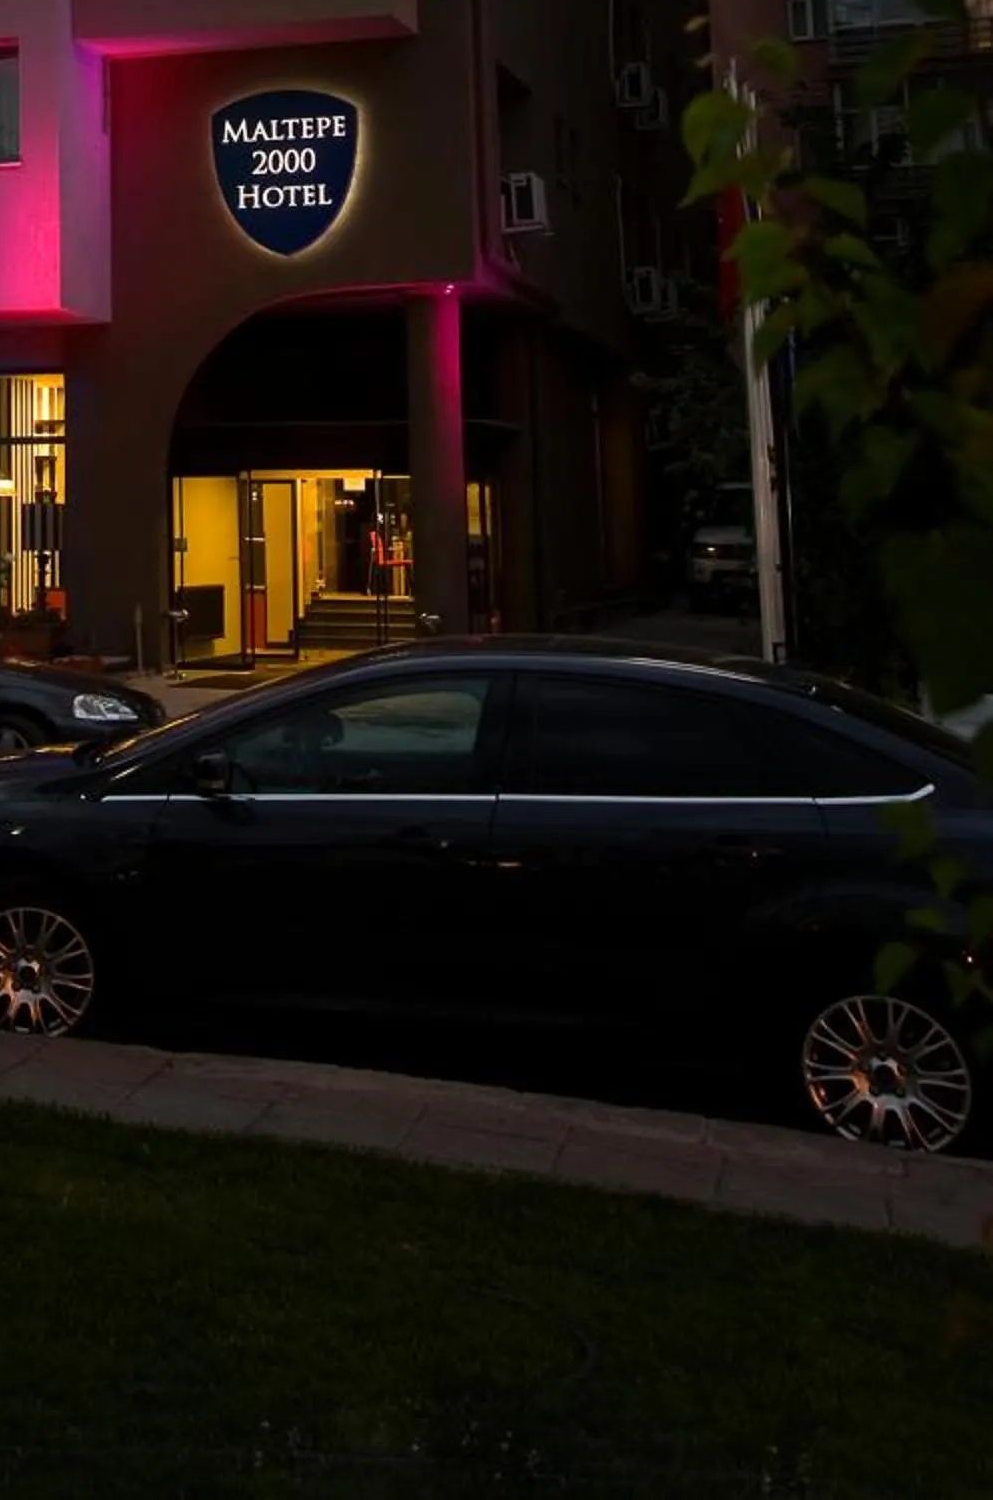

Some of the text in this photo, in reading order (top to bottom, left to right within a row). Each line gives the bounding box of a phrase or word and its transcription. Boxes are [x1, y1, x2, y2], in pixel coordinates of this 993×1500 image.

[221, 115, 346, 144] MALTEPE
[251, 147, 316, 175] 2000
[236, 183, 333, 209] HOTEL
